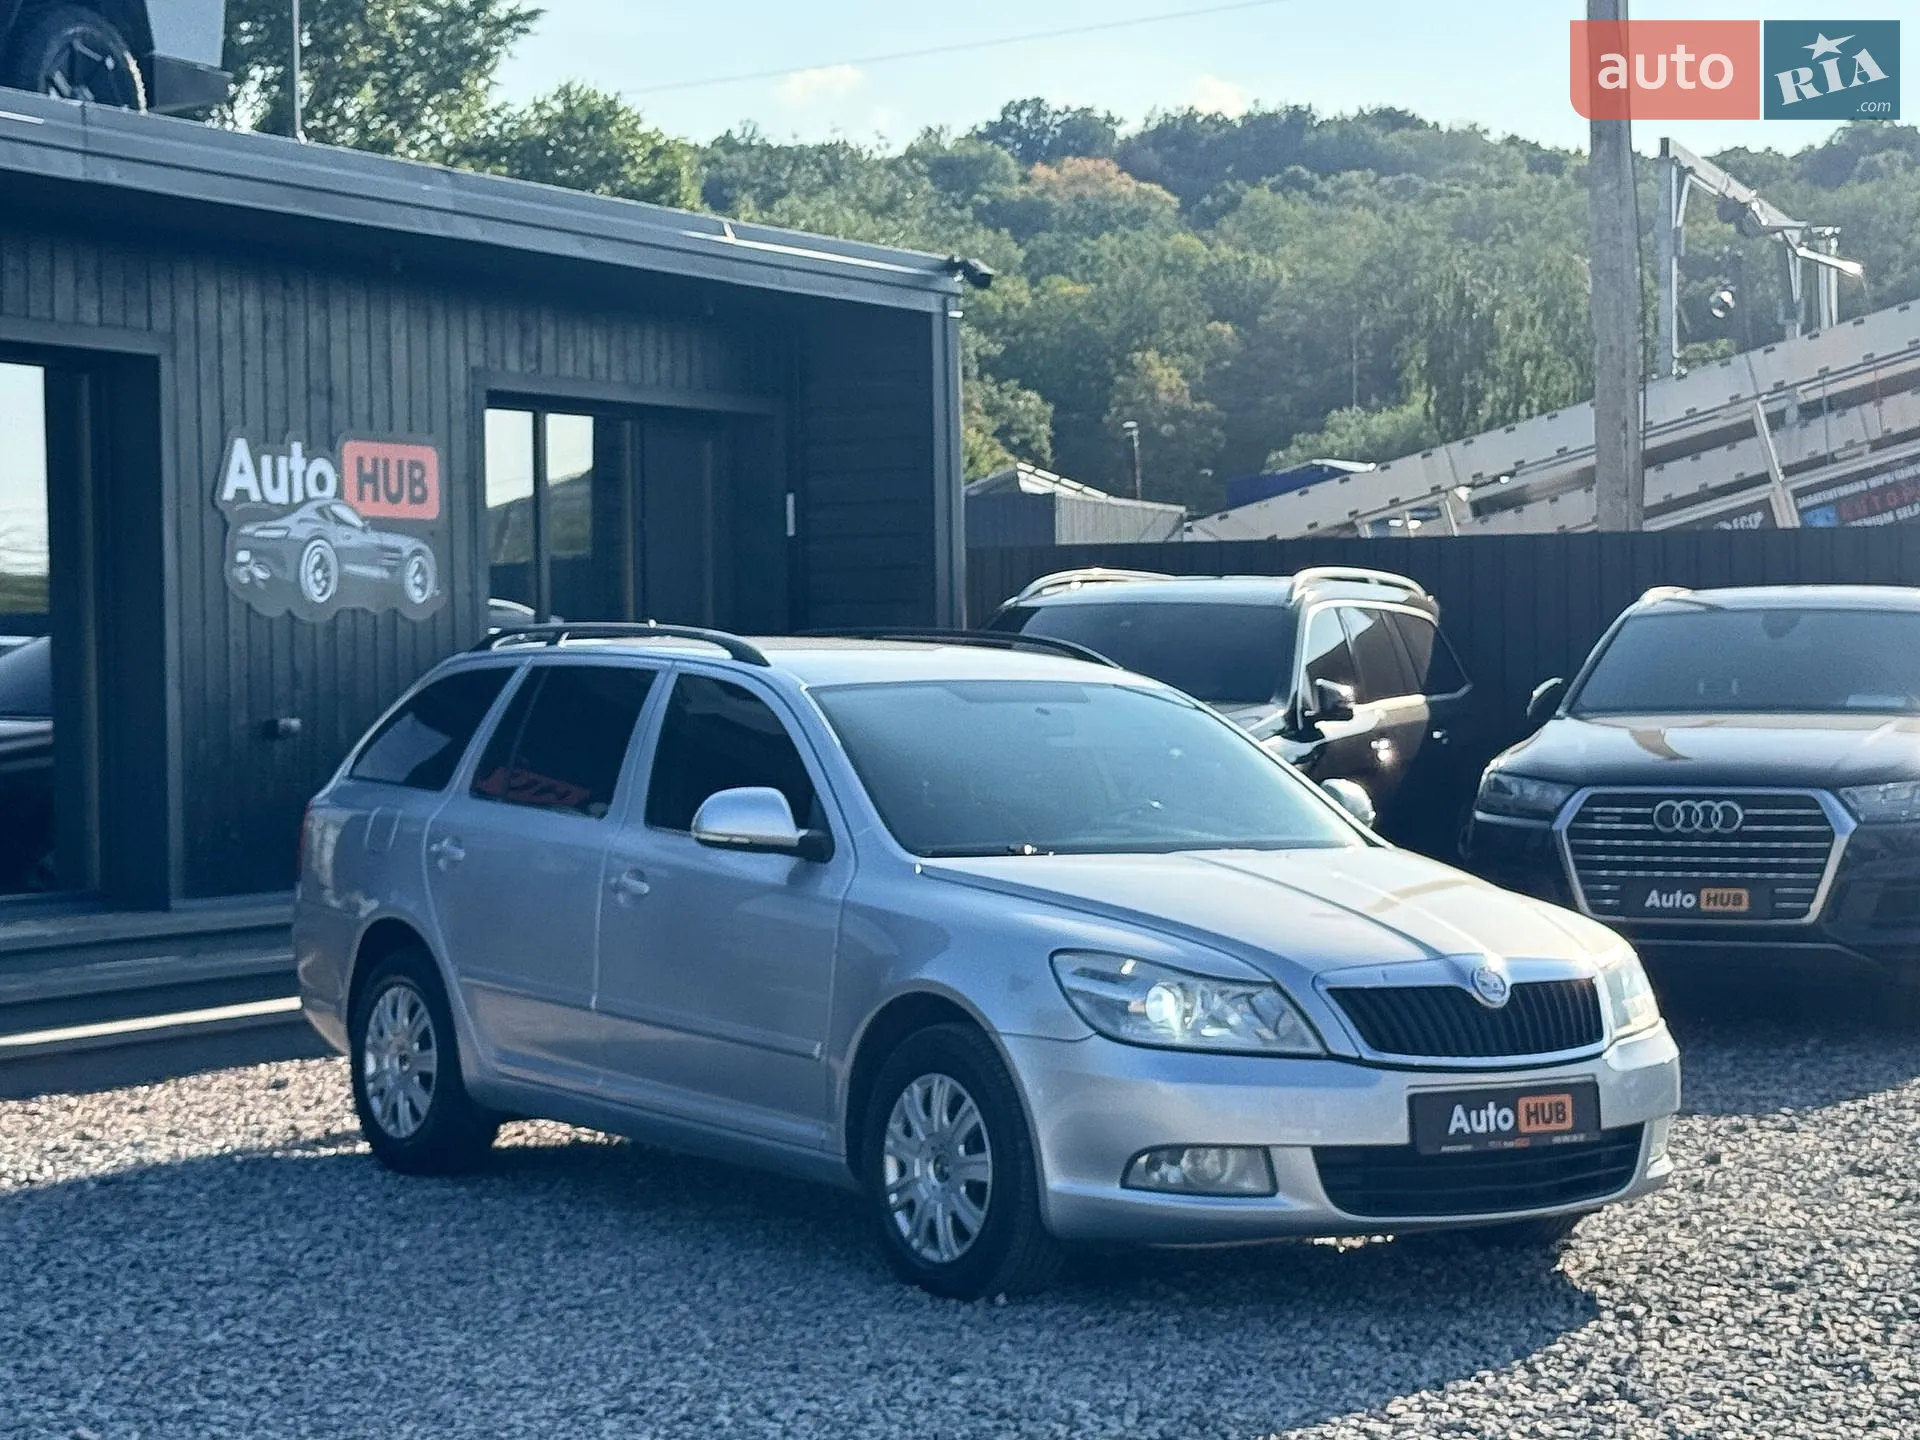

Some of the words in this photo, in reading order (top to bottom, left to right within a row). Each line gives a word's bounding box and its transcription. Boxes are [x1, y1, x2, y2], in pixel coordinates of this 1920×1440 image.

[222, 438, 338, 504] Auto
[356, 456, 428, 505] HUB
[1644, 888, 1696, 909] Auto
[1706, 892, 1743, 907] HUB
[1448, 1101, 1515, 1136] Auto
[1525, 1101, 1566, 1127] HUB
